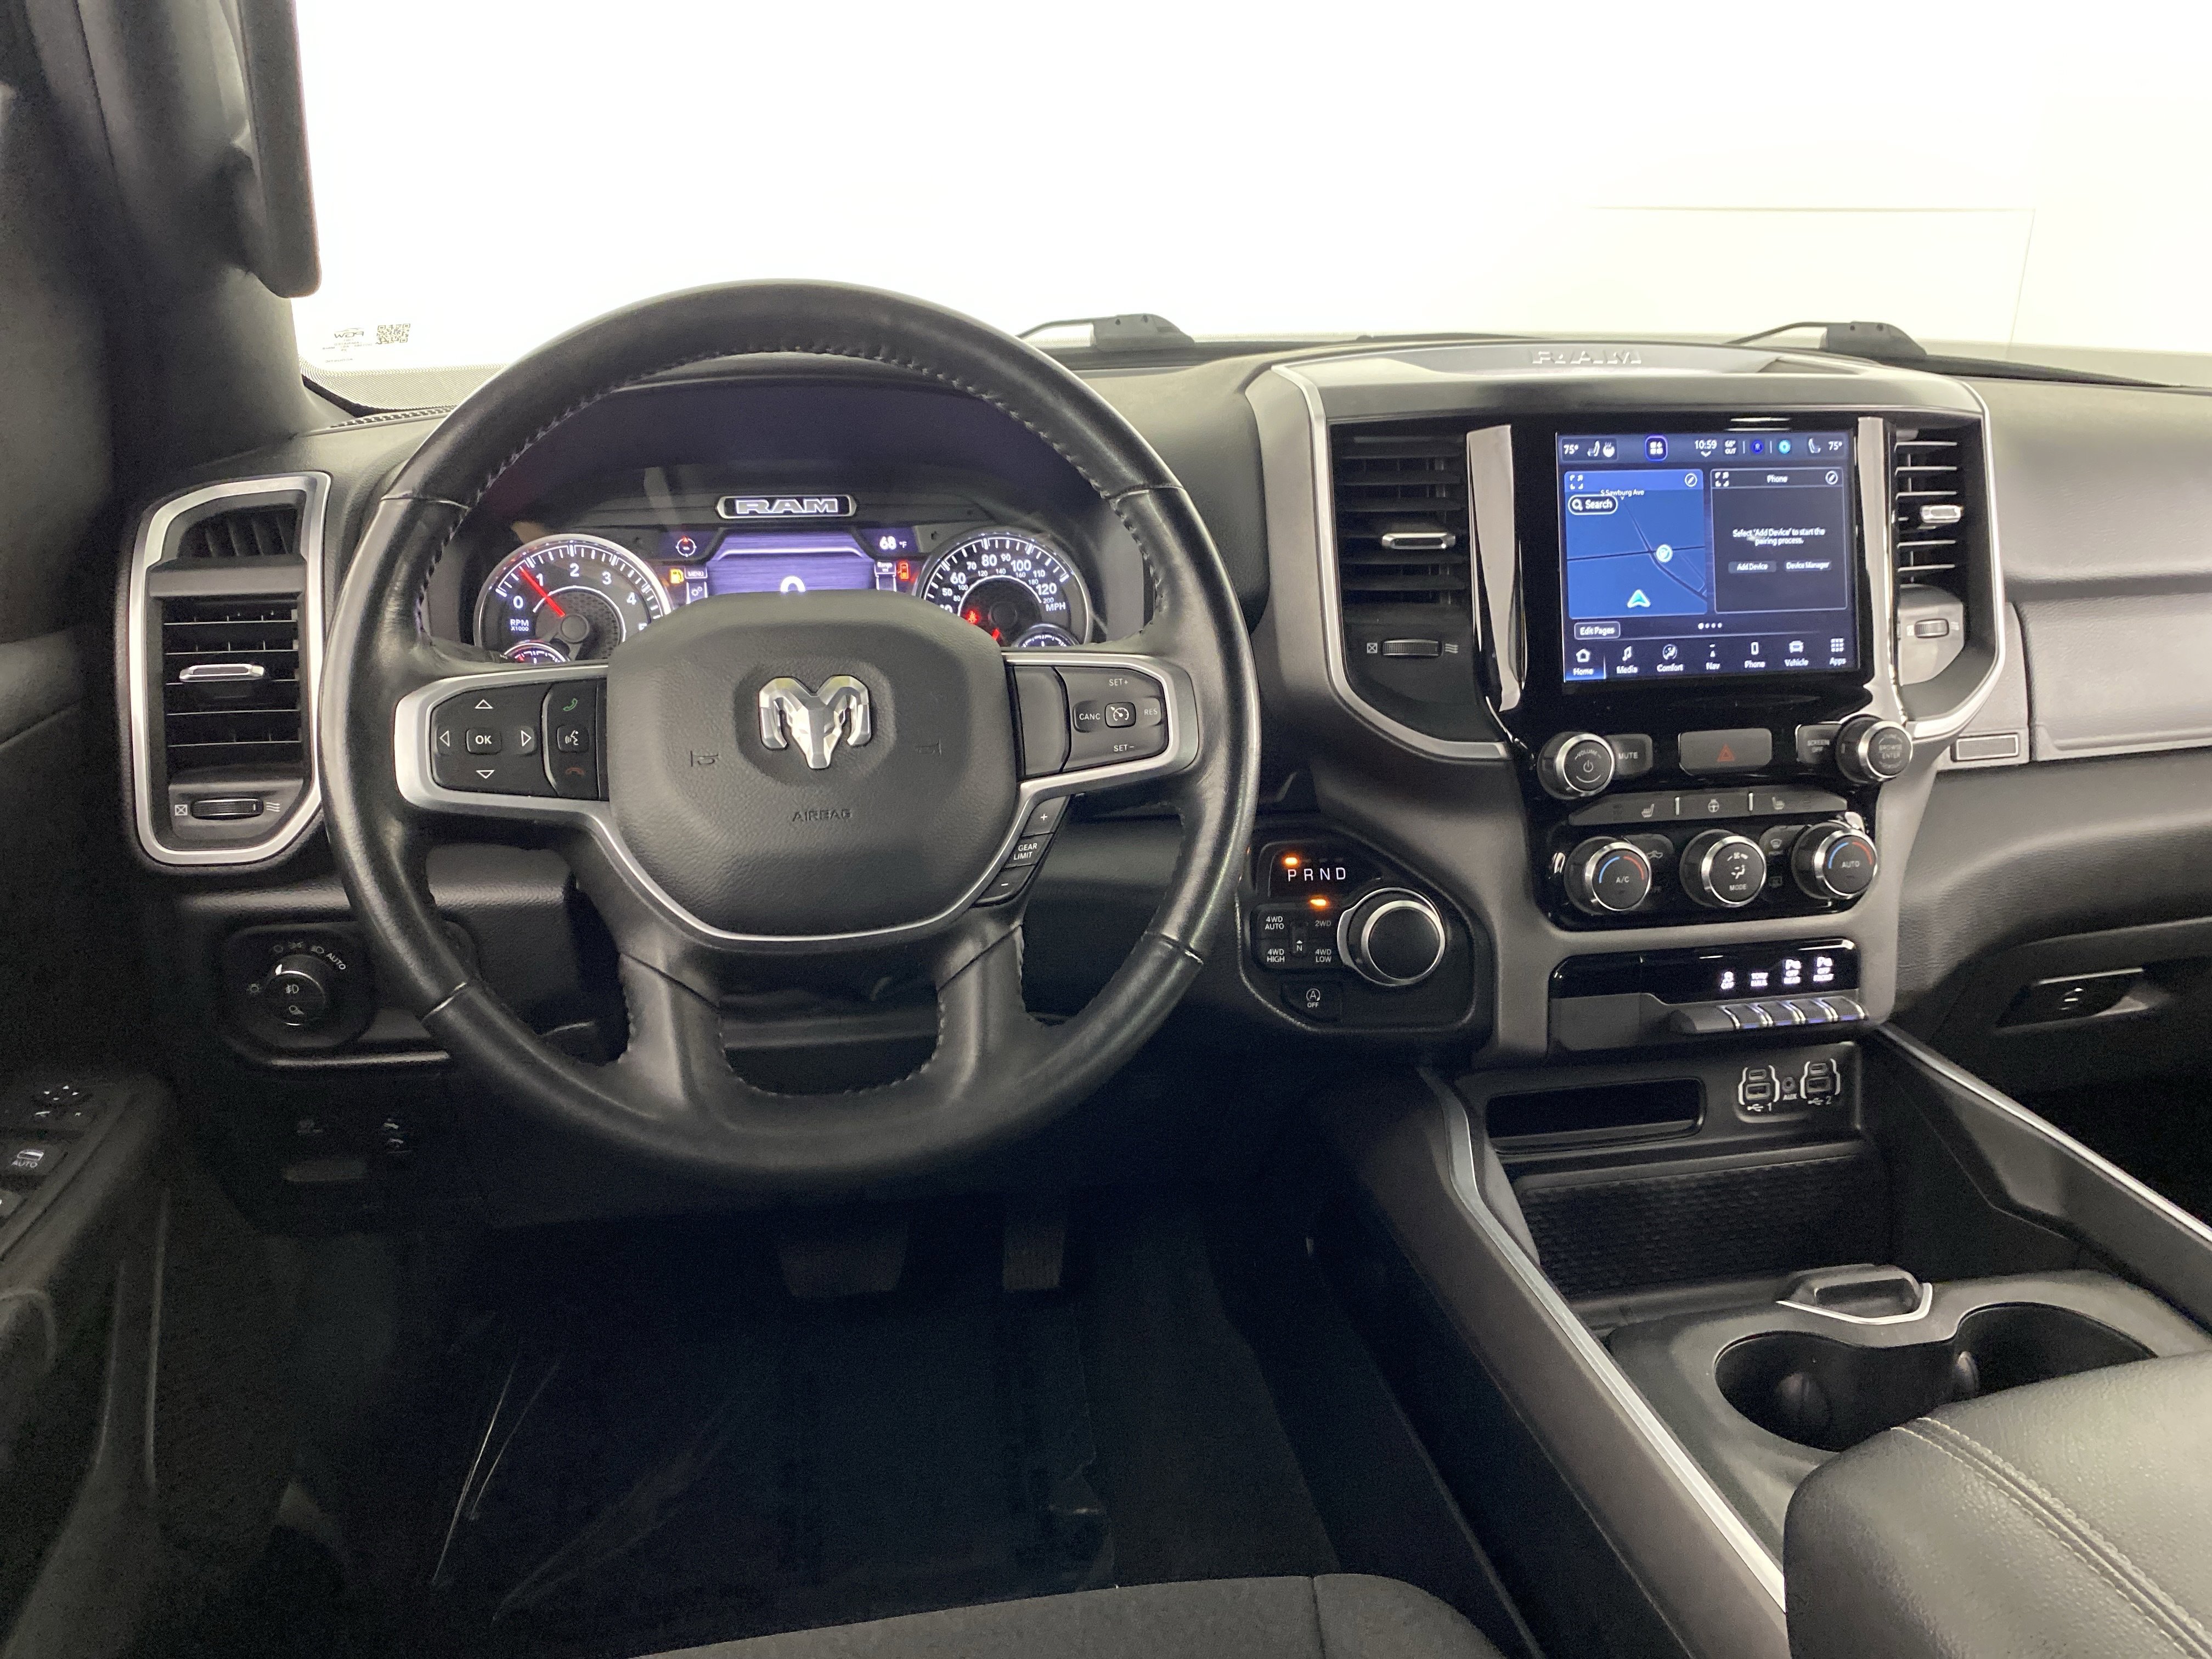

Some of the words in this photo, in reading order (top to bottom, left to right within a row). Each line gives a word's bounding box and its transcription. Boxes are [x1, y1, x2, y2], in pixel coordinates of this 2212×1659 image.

[1530, 349, 1642, 364] RAM
[1695, 439, 1717, 450] 10:59
[1767, 474, 1788, 483] Phone
[736, 499, 838, 514] RAM
[1585, 499, 1612, 509] Search
[1733, 528, 1753, 537] Select
[1814, 527, 1826, 535] the
[879, 536, 897, 550] 68
[1755, 537, 1778, 546] pairing
[981, 554, 997, 567] 80
[1000, 553, 1011, 562] 90
[569, 563, 579, 577] 2
[967, 561, 977, 570] 70
[1011, 560, 1031, 572] 100
[602, 571, 612, 585] 3
[1032, 569, 1046, 578] 110
[535, 573, 544, 586] 1
[950, 572, 966, 585] 60
[942, 588, 952, 596] 50
[1036, 583, 1057, 595] 120
[513, 595, 524, 609] 0
[627, 592, 636, 605] 4
[1045, 602, 1066, 612] MPH
[1580, 627, 1594, 636] Edit
[1594, 627, 1615, 636] Pages
[1706, 662, 1720, 670] Nav
[1745, 660, 1765, 668] Phone
[1785, 658, 1809, 667] Vehicle
[1830, 657, 1846, 666] Apps
[1616, 665, 1638, 674] Media
[1657, 663, 1684, 672] Comfort
[1079, 713, 1101, 721] CANC
[475, 735, 492, 744] OK
[1577, 749, 1599, 757] VOLUME
[792, 809, 852, 822] AIRBAG
[1018, 842, 1037, 852] GEAR
[1013, 850, 1032, 861] LIMIT
[1842, 860, 1860, 868] AUTO
[1288, 868, 1296, 882] P
[1304, 868, 1313, 881] R
[1320, 867, 1330, 881] N
[1336, 867, 1346, 880] D
[1729, 883, 1747, 891] MODE
[326, 952, 347, 970] AUTO
[1825, 1096, 1832, 1105] 2
[1767, 1103, 1772, 1111] 1
[11, 1160, 38, 1168] AUTO
